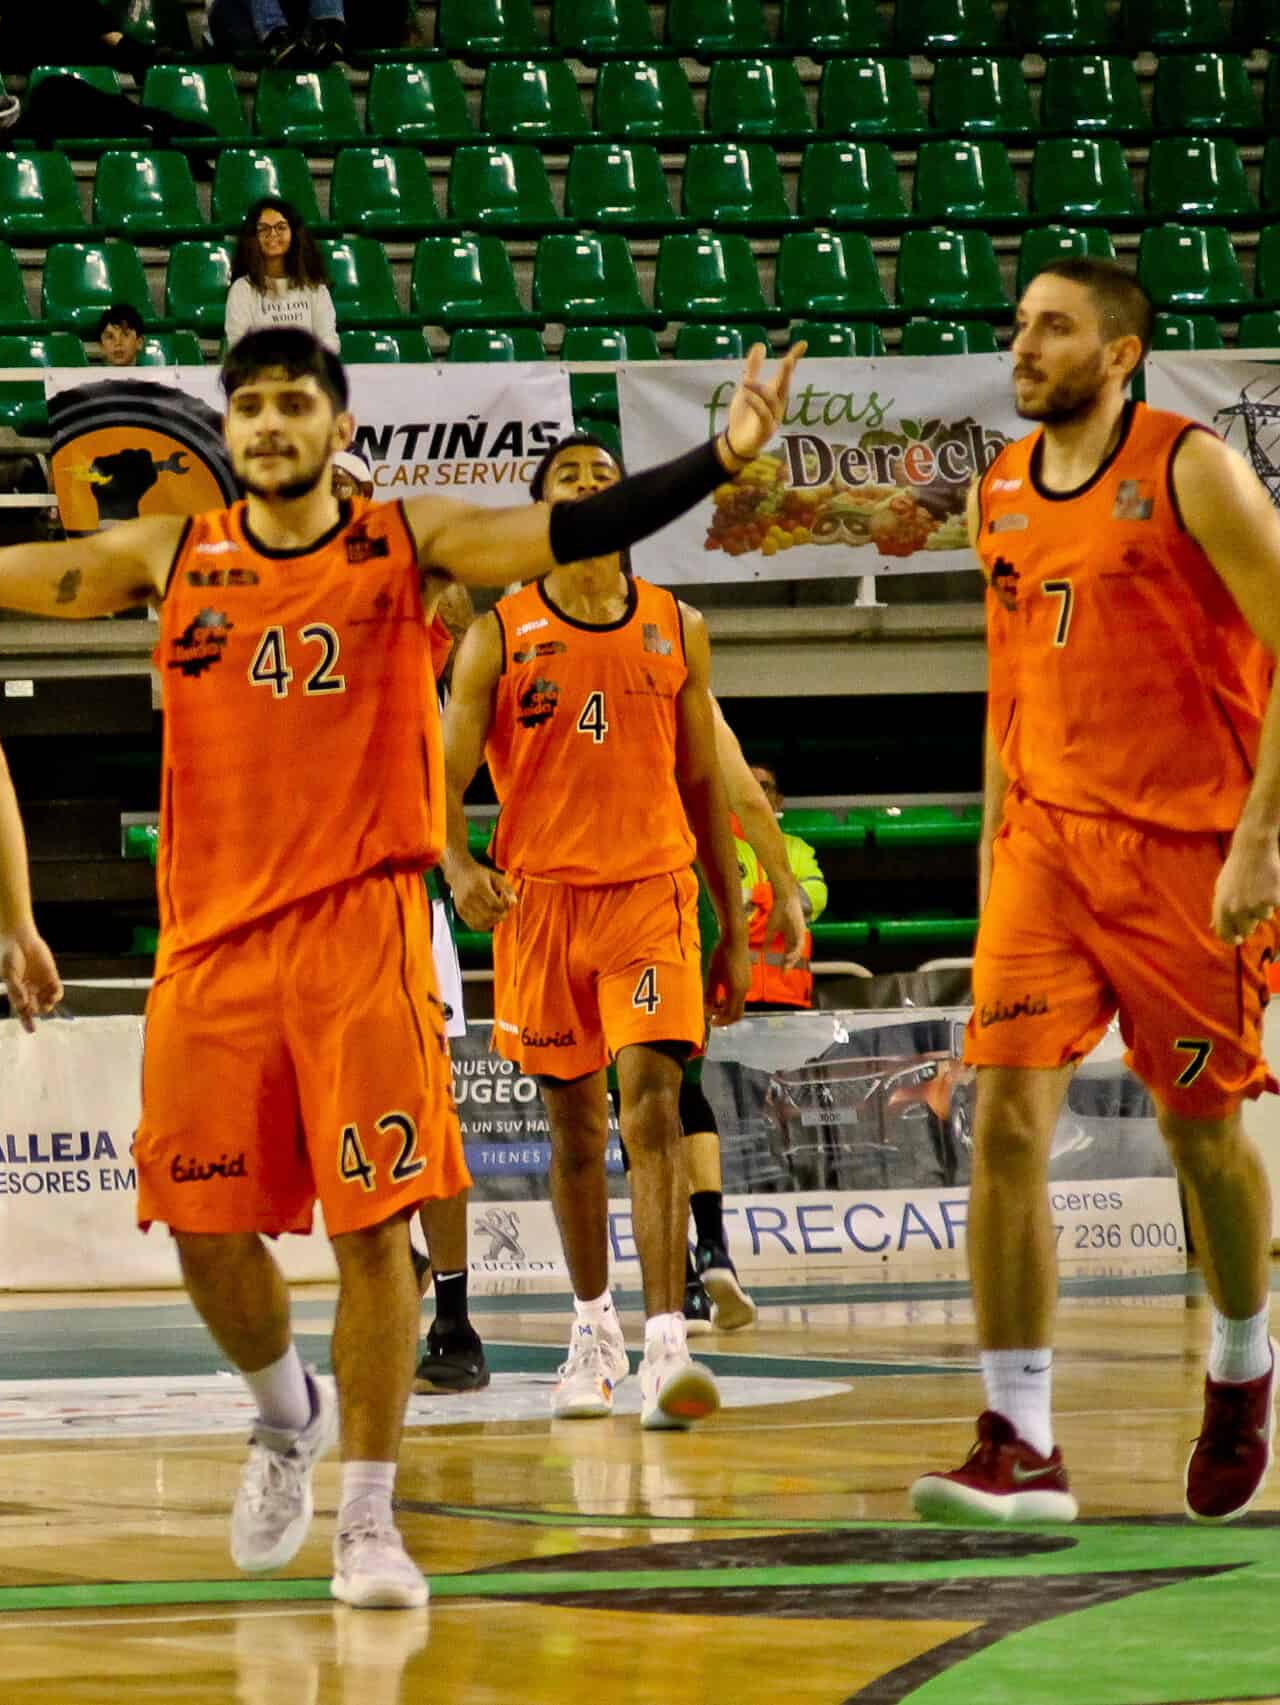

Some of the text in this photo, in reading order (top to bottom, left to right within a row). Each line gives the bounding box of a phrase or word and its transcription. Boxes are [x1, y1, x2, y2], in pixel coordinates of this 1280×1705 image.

[352, 414, 561, 461] NTIÑAS
[781, 423, 1009, 488] Derech
[373, 460, 539, 487] CAR SERVIC
[1041, 578, 1074, 648] 7
[248, 621, 346, 699] 42
[576, 690, 609, 744] 4
[631, 965, 662, 1015] 4
[450, 1059, 514, 1076] NUEVO
[1174, 1038, 1214, 1088] 7
[451, 1076, 538, 1105] UGEO
[472, 1121, 493, 1134] UN
[496, 1120, 524, 1134] SUV
[336, 1109, 428, 1193] 42
[99, 1167, 137, 1192] EM
[1051, 1191, 1124, 1211] ceres
[1074, 1223, 1121, 1249] 236
[1130, 1222, 1178, 1248] 000
[470, 1261, 558, 1273] EUGEOT
